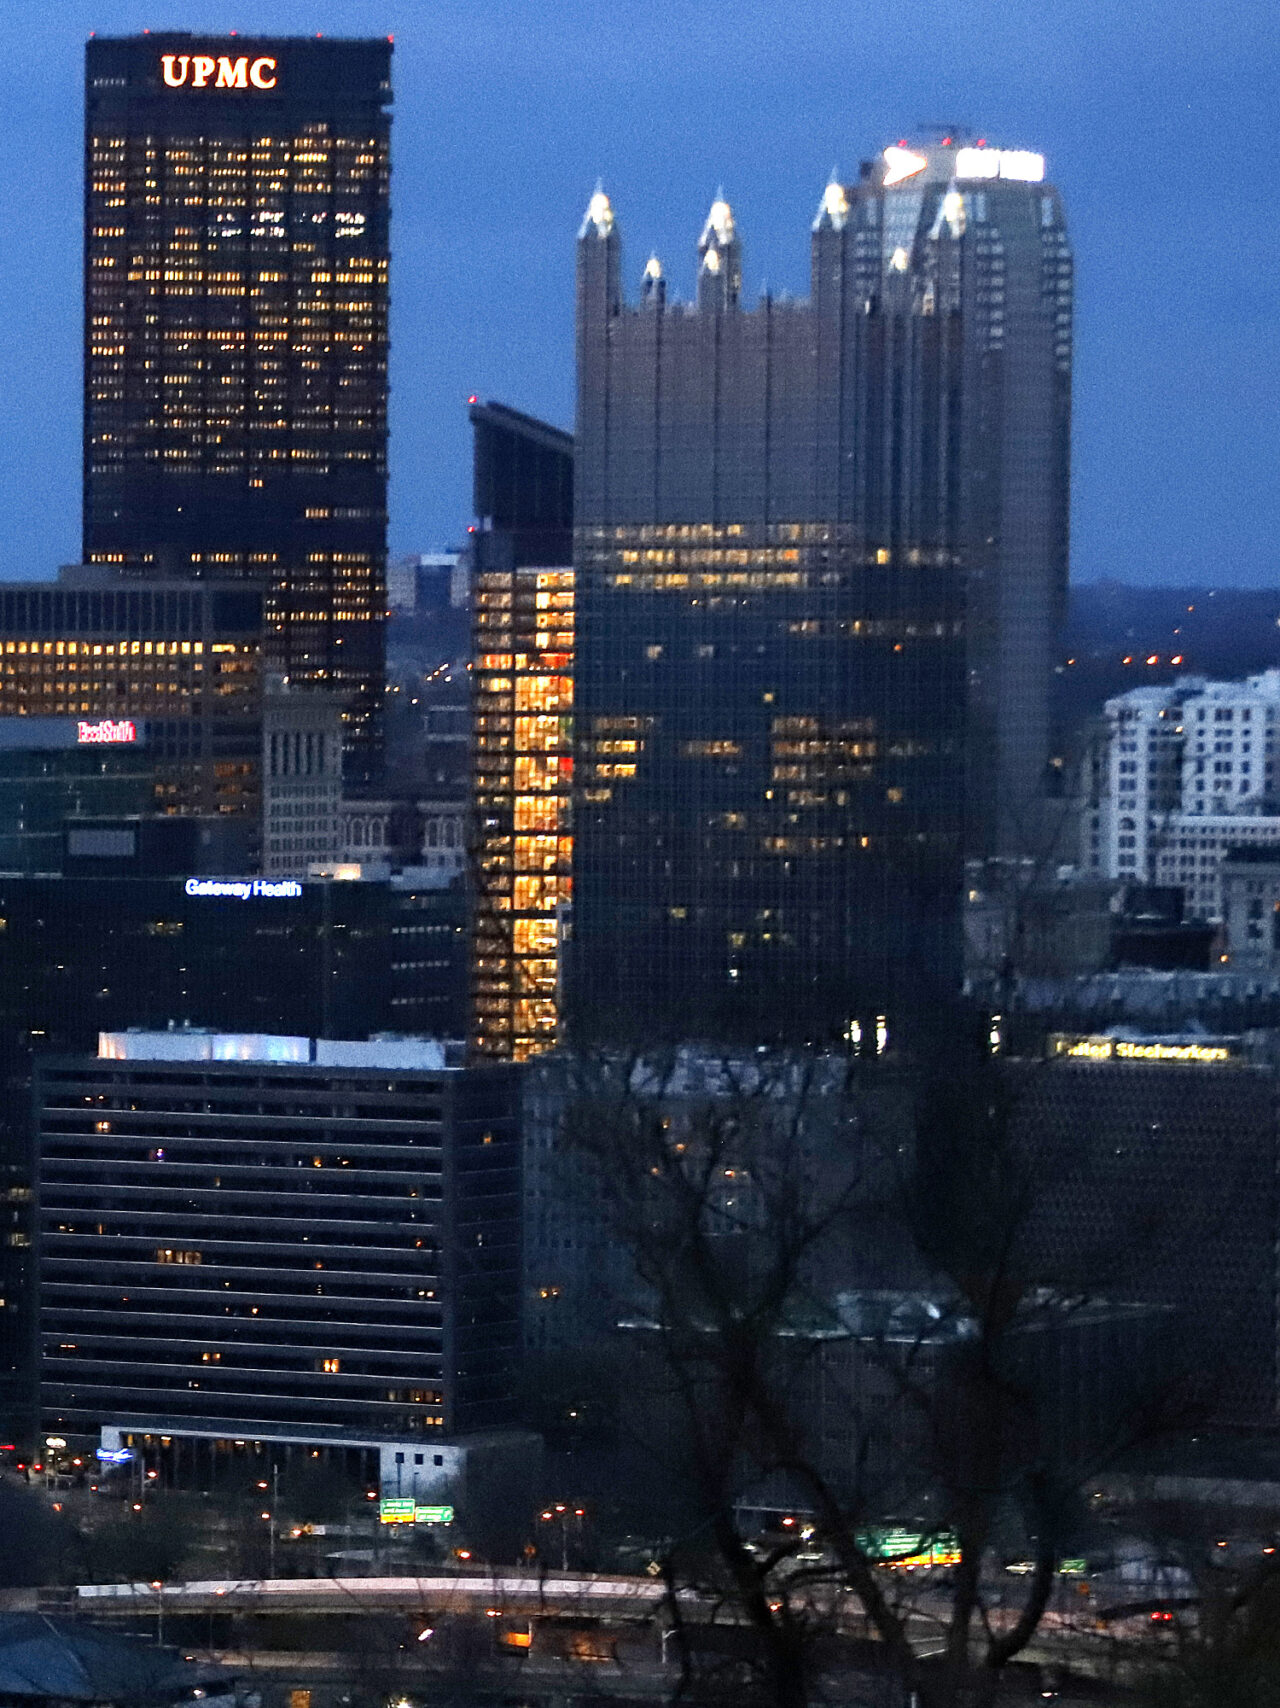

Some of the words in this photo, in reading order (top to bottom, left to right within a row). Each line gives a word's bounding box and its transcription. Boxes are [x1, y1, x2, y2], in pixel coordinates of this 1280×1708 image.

[160, 54, 277, 89] UPMC
[185, 878, 251, 900] Gateway
[253, 880, 302, 897] Health
